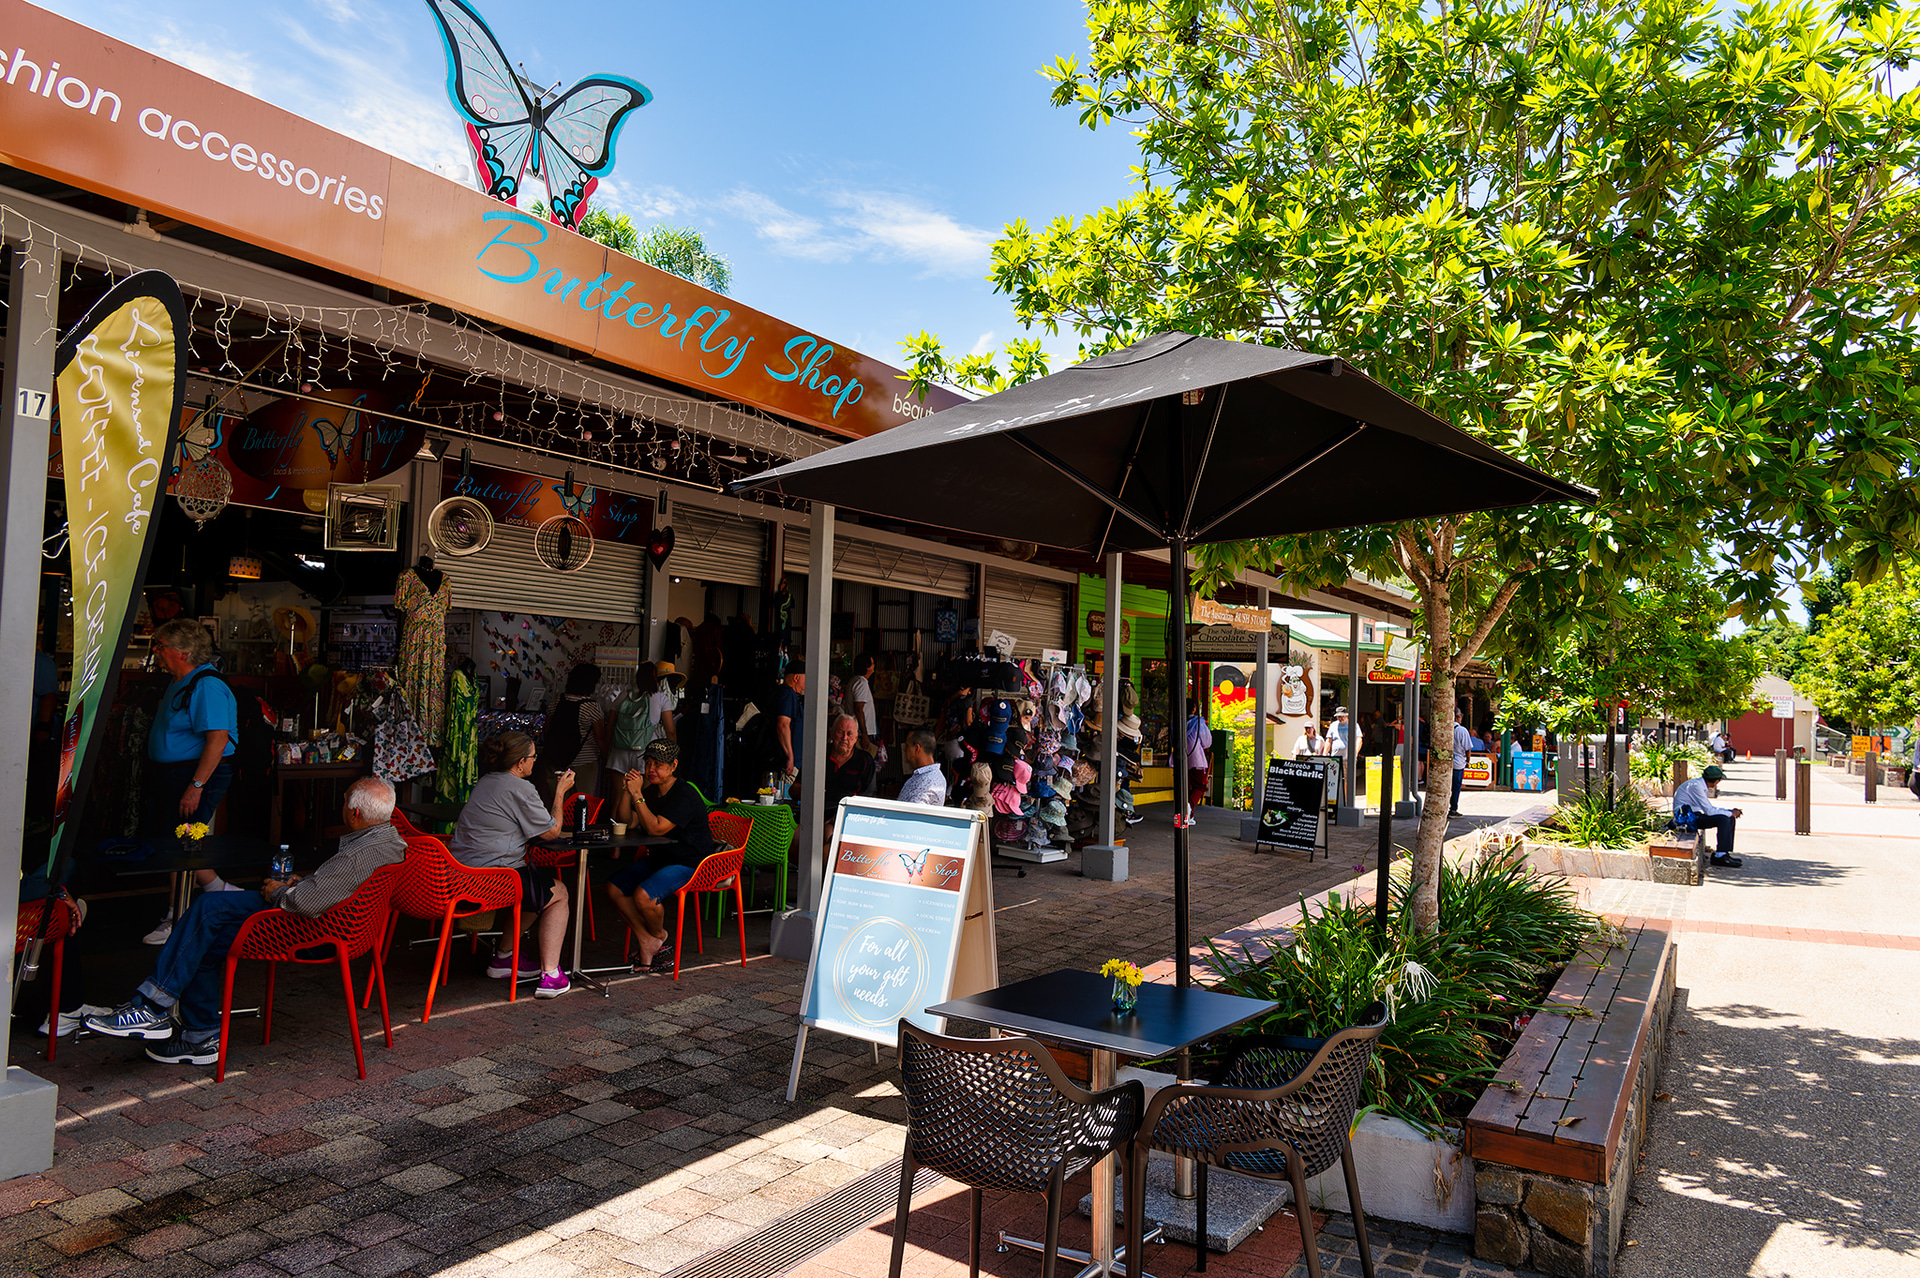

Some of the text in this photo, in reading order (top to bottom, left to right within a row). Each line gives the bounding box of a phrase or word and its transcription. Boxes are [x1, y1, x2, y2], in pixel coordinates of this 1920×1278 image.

[138, 106, 385, 220] accessories
[476, 210, 755, 378] Butterfly
[764, 335, 864, 419] Shop
[18, 390, 47, 416] 17
[75, 333, 112, 492] COFFEE
[119, 307, 162, 535] Licensed Cafe
[243, 404, 406, 476] Butterfly Shop
[453, 475, 640, 538] Butterfly Shop
[505, 516, 523, 526] Local
[82, 510, 109, 585] ICE
[1201, 606, 1267, 627] The Australian BUSH STORE
[77, 580, 108, 701] CREAM
[1198, 632, 1245, 643] Chocolate
[1269, 766, 1324, 779] Black Garlic
[1283, 761, 1311, 770] Mareeba
[841, 849, 960, 886] Butterfly Shop
[858, 934, 910, 962] For all
[847, 960, 911, 990] your gift
[853, 984, 889, 1008] needs.
